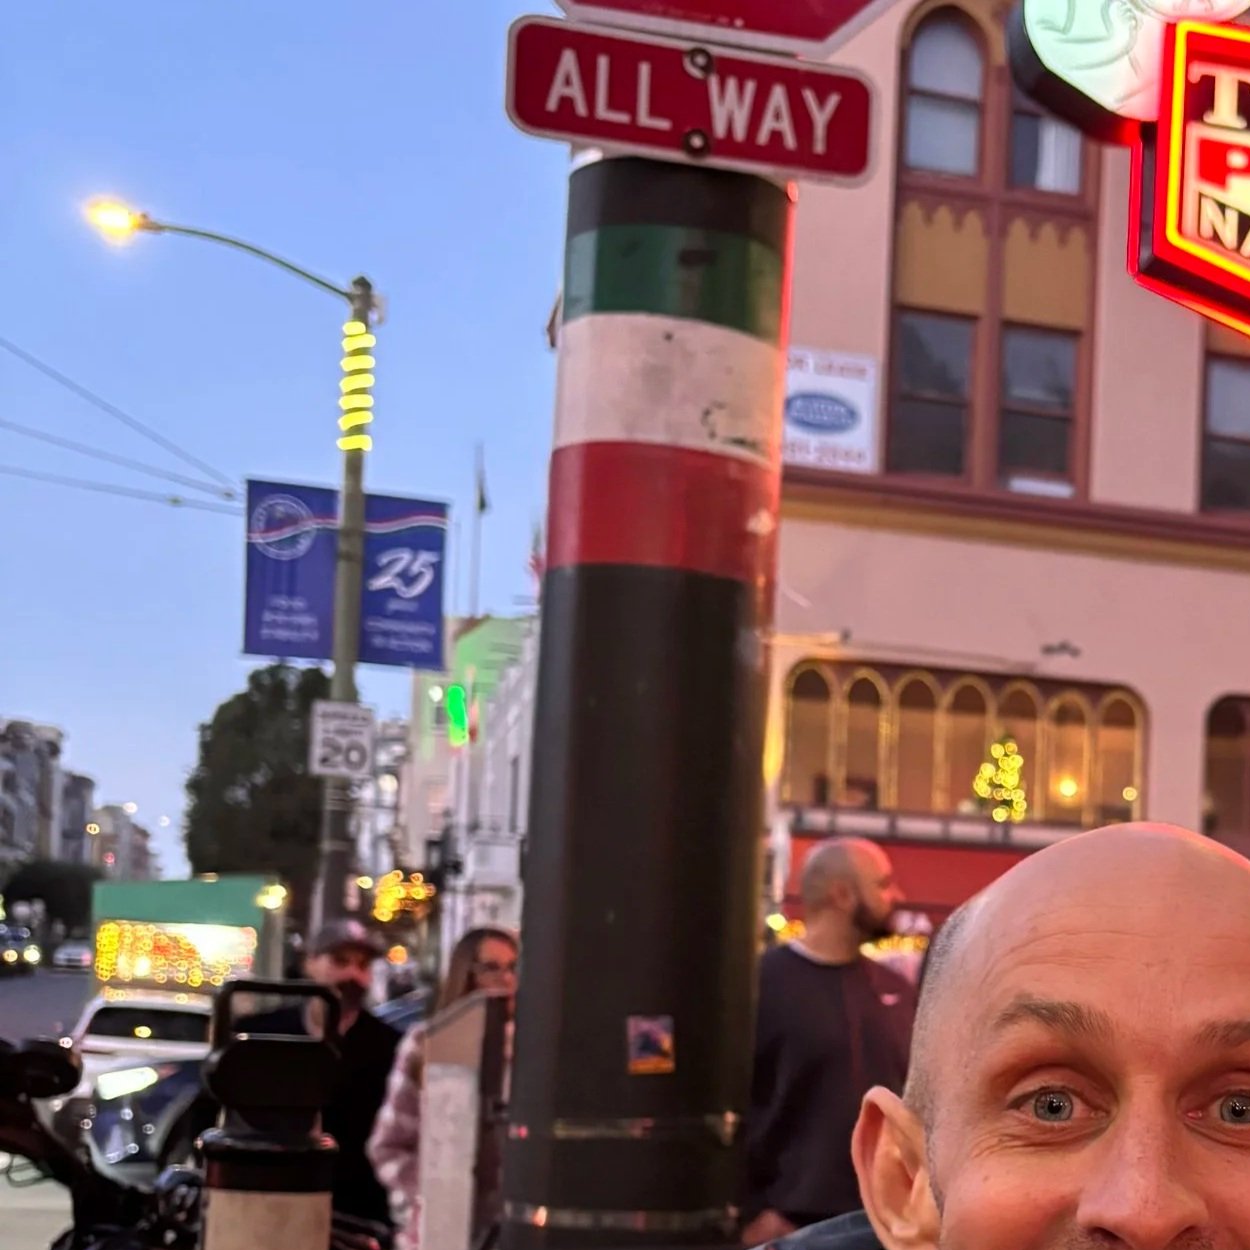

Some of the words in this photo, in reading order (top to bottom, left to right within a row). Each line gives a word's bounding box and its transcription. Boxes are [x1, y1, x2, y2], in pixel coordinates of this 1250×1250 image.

[545, 48, 673, 131] ALL
[708, 73, 842, 155] WAY
[367, 547, 440, 599] 25
[319, 736, 368, 773] 20
